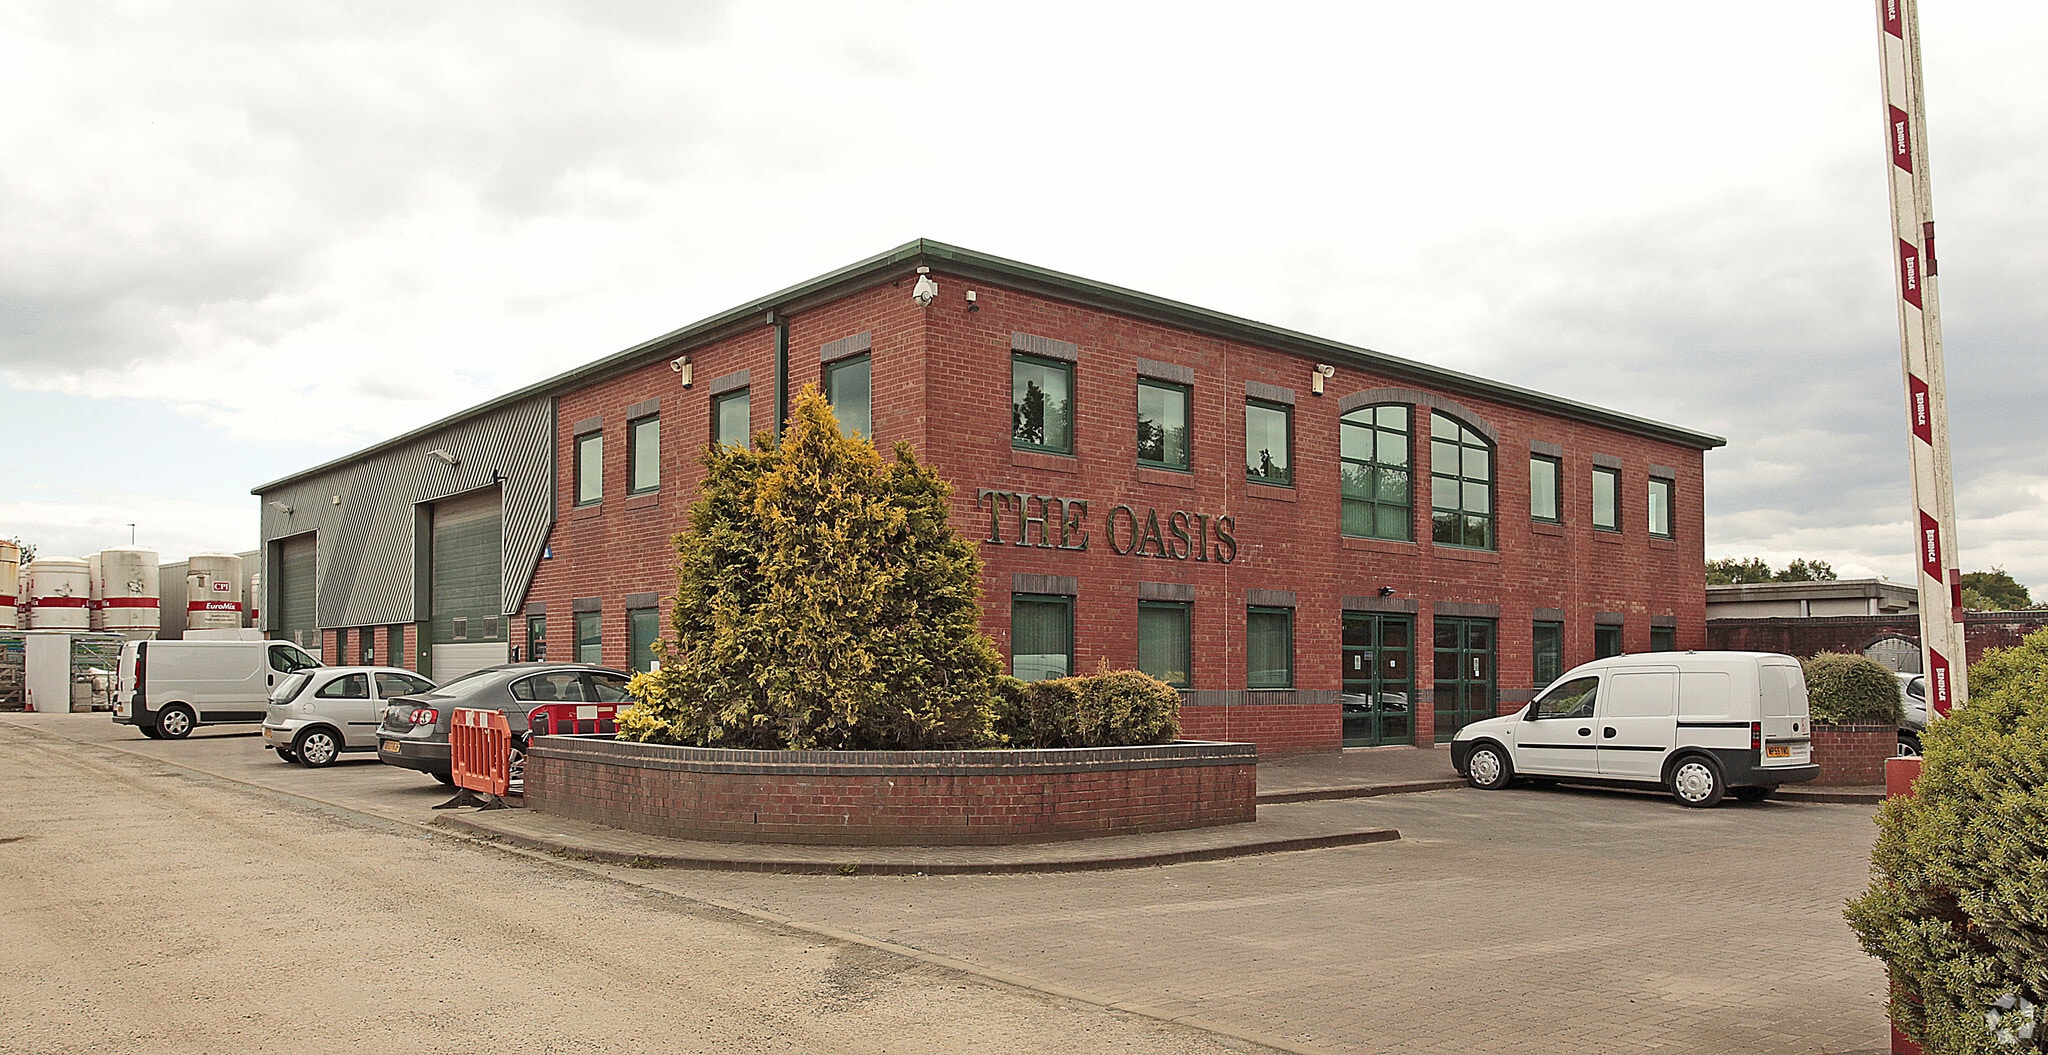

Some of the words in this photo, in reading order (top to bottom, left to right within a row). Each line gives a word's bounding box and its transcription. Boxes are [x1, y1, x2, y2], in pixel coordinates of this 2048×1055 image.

[977, 488, 1089, 550] THE
[1107, 504, 1237, 563] OASIS
[206, 602, 236, 610] EuroMix
